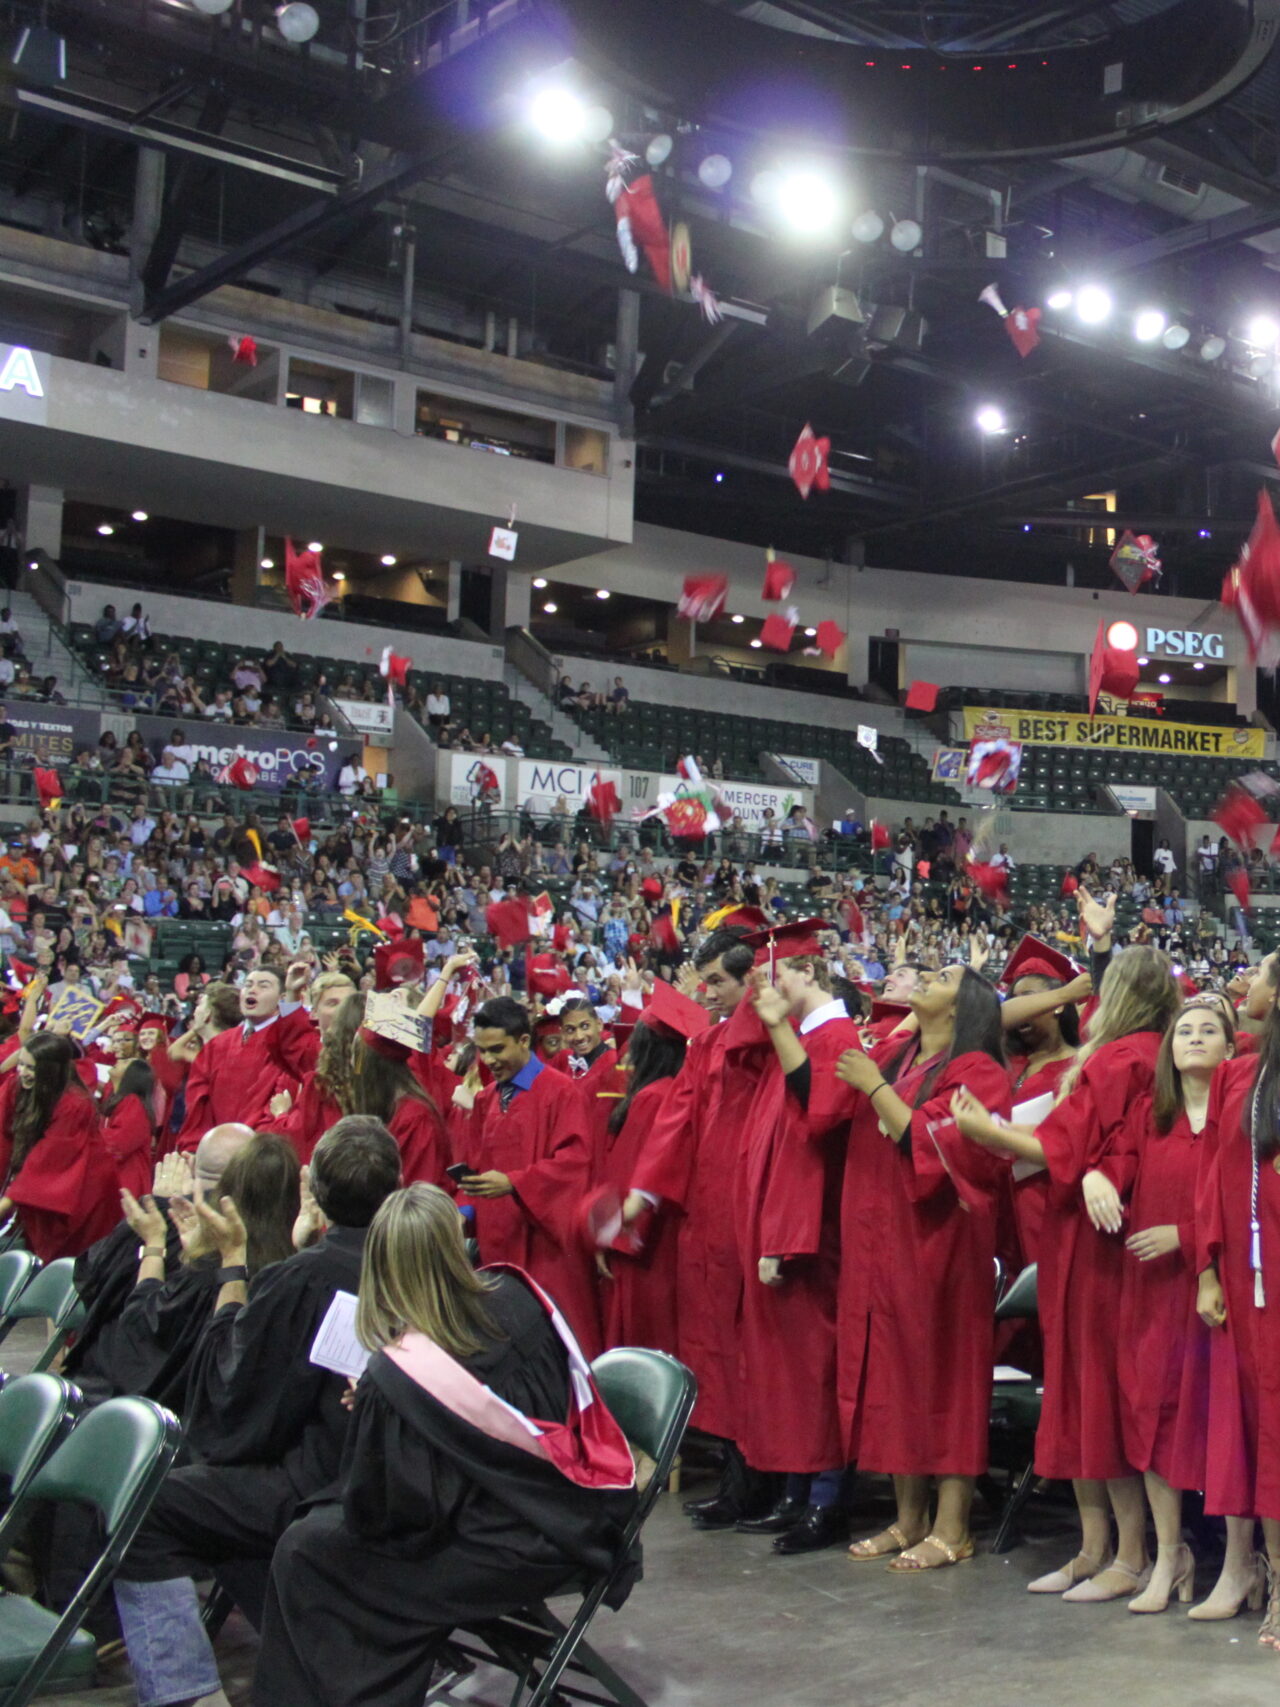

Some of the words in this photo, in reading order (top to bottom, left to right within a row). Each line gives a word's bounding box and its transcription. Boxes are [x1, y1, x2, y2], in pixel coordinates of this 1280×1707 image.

[1146, 627, 1224, 658] PSEG
[1018, 718, 1069, 742] BEST
[1076, 722, 1222, 752] SUPERMARKET
[191, 743, 325, 775] metroPCS
[790, 760, 815, 771] CURE
[630, 775, 649, 799] 107
[725, 790, 778, 807] MERCER
